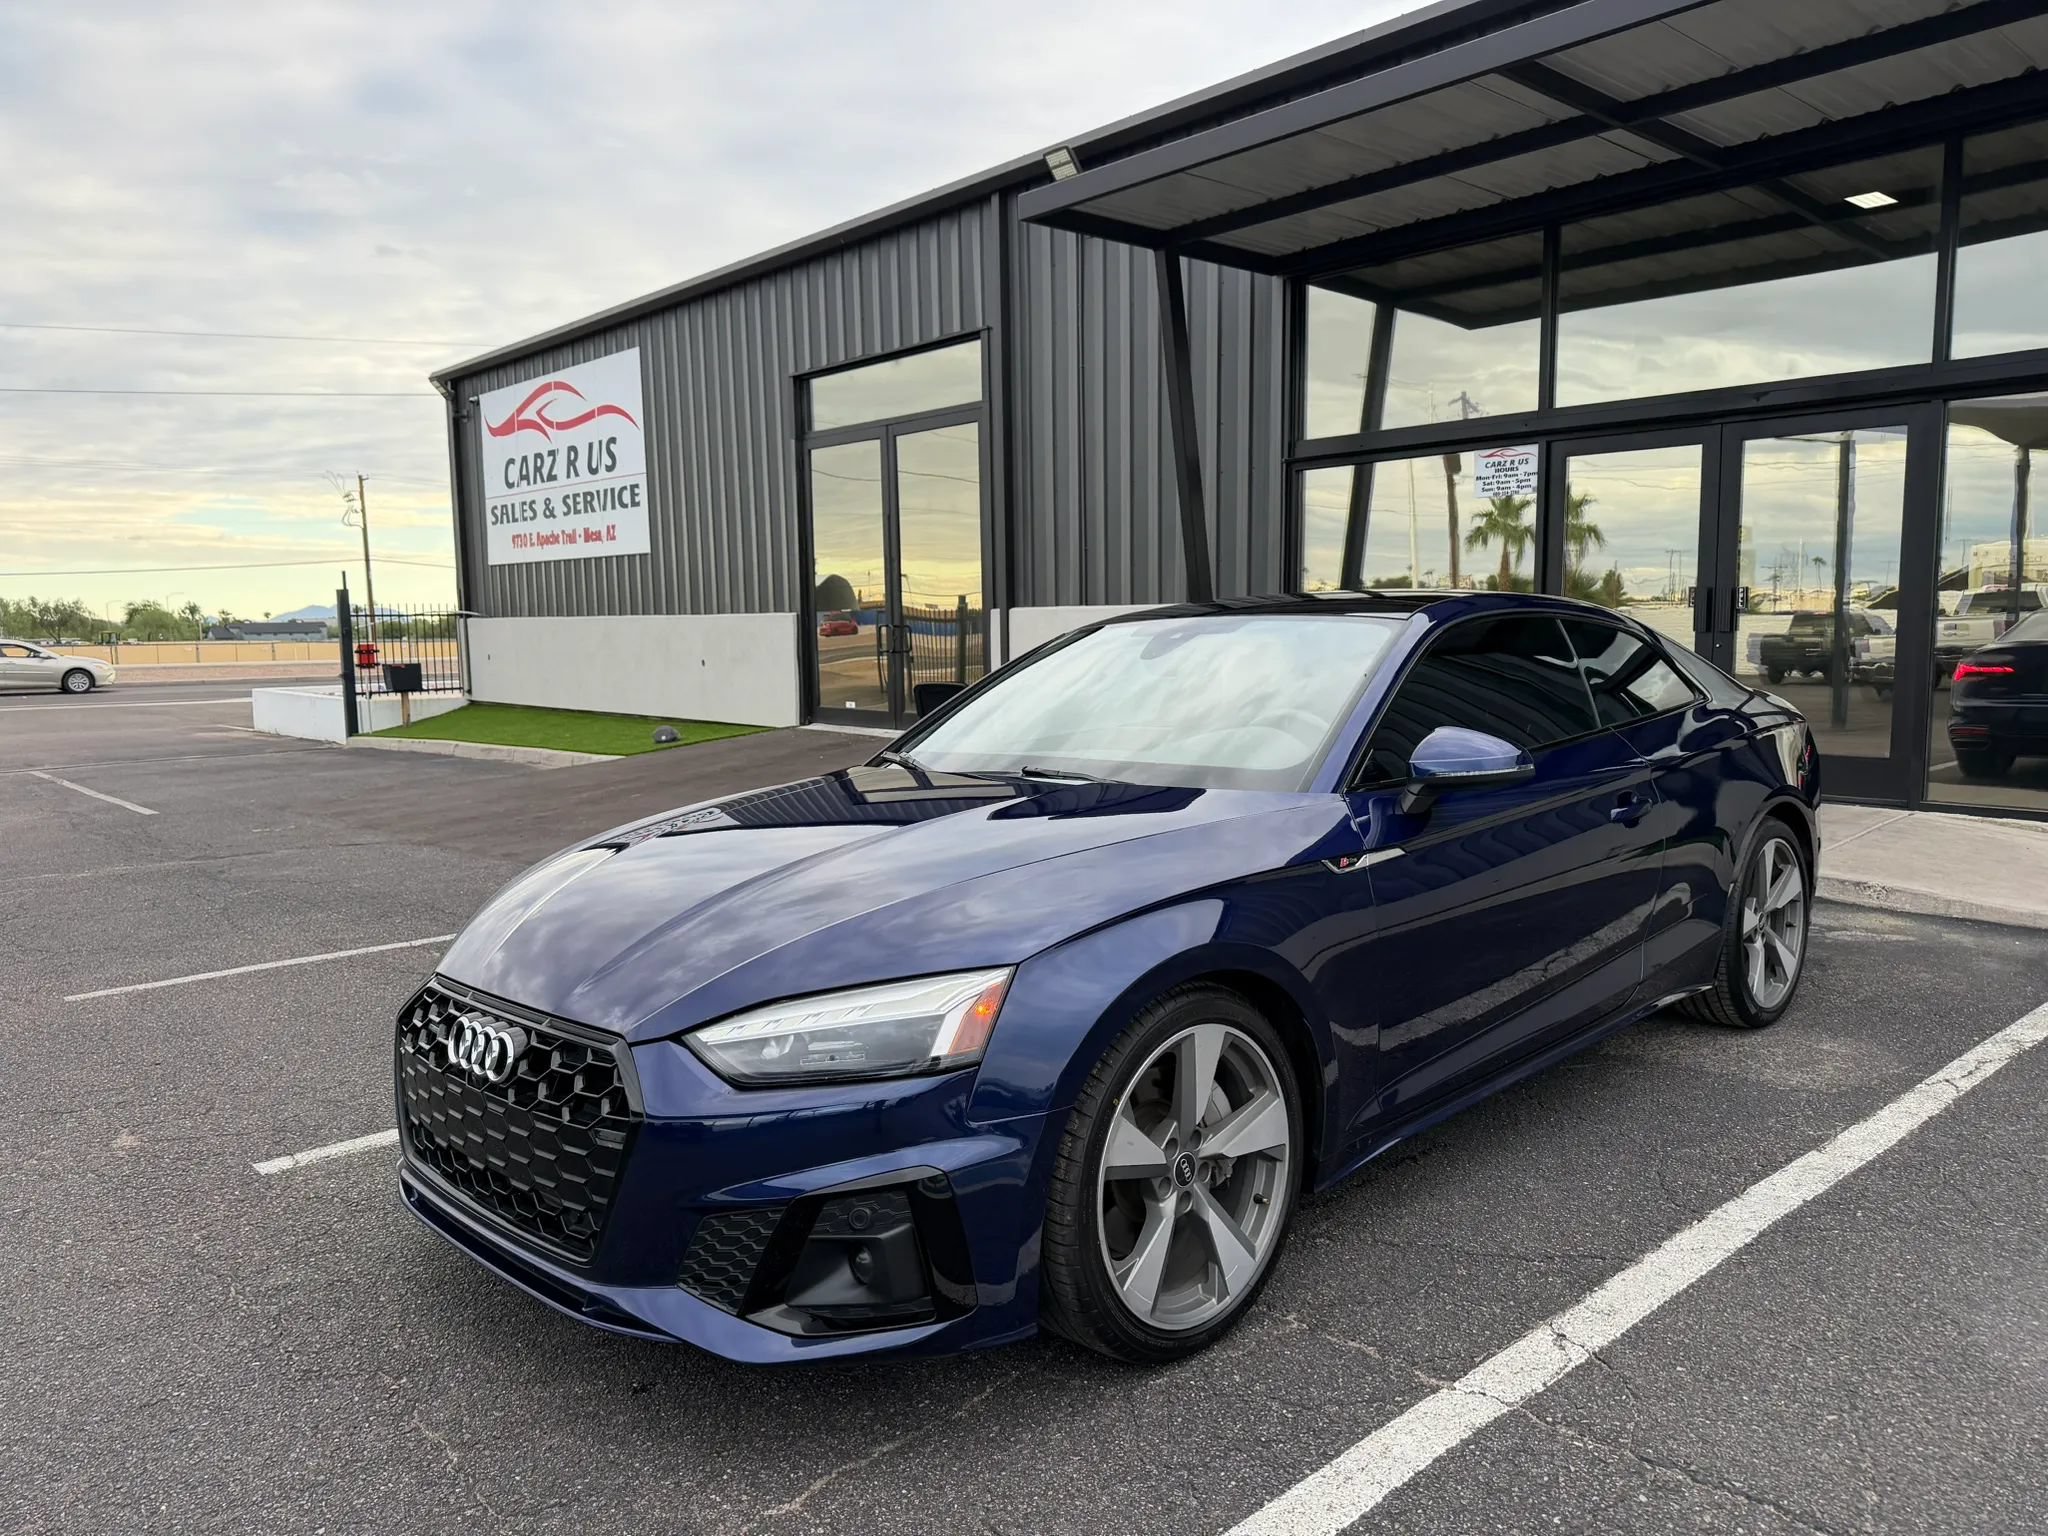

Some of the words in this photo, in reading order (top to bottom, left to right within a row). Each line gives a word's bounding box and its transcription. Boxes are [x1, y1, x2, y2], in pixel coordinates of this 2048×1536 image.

[566, 445, 580, 479] R
[587, 436, 617, 475] US
[1485, 460, 1508, 469] CARZ
[490, 499, 538, 525] SALES
[543, 497, 557, 519] &
[562, 483, 641, 517] SERVICE
[536, 530, 560, 549] Apache
[561, 528, 577, 545] Trail
[606, 524, 616, 541] AZ
